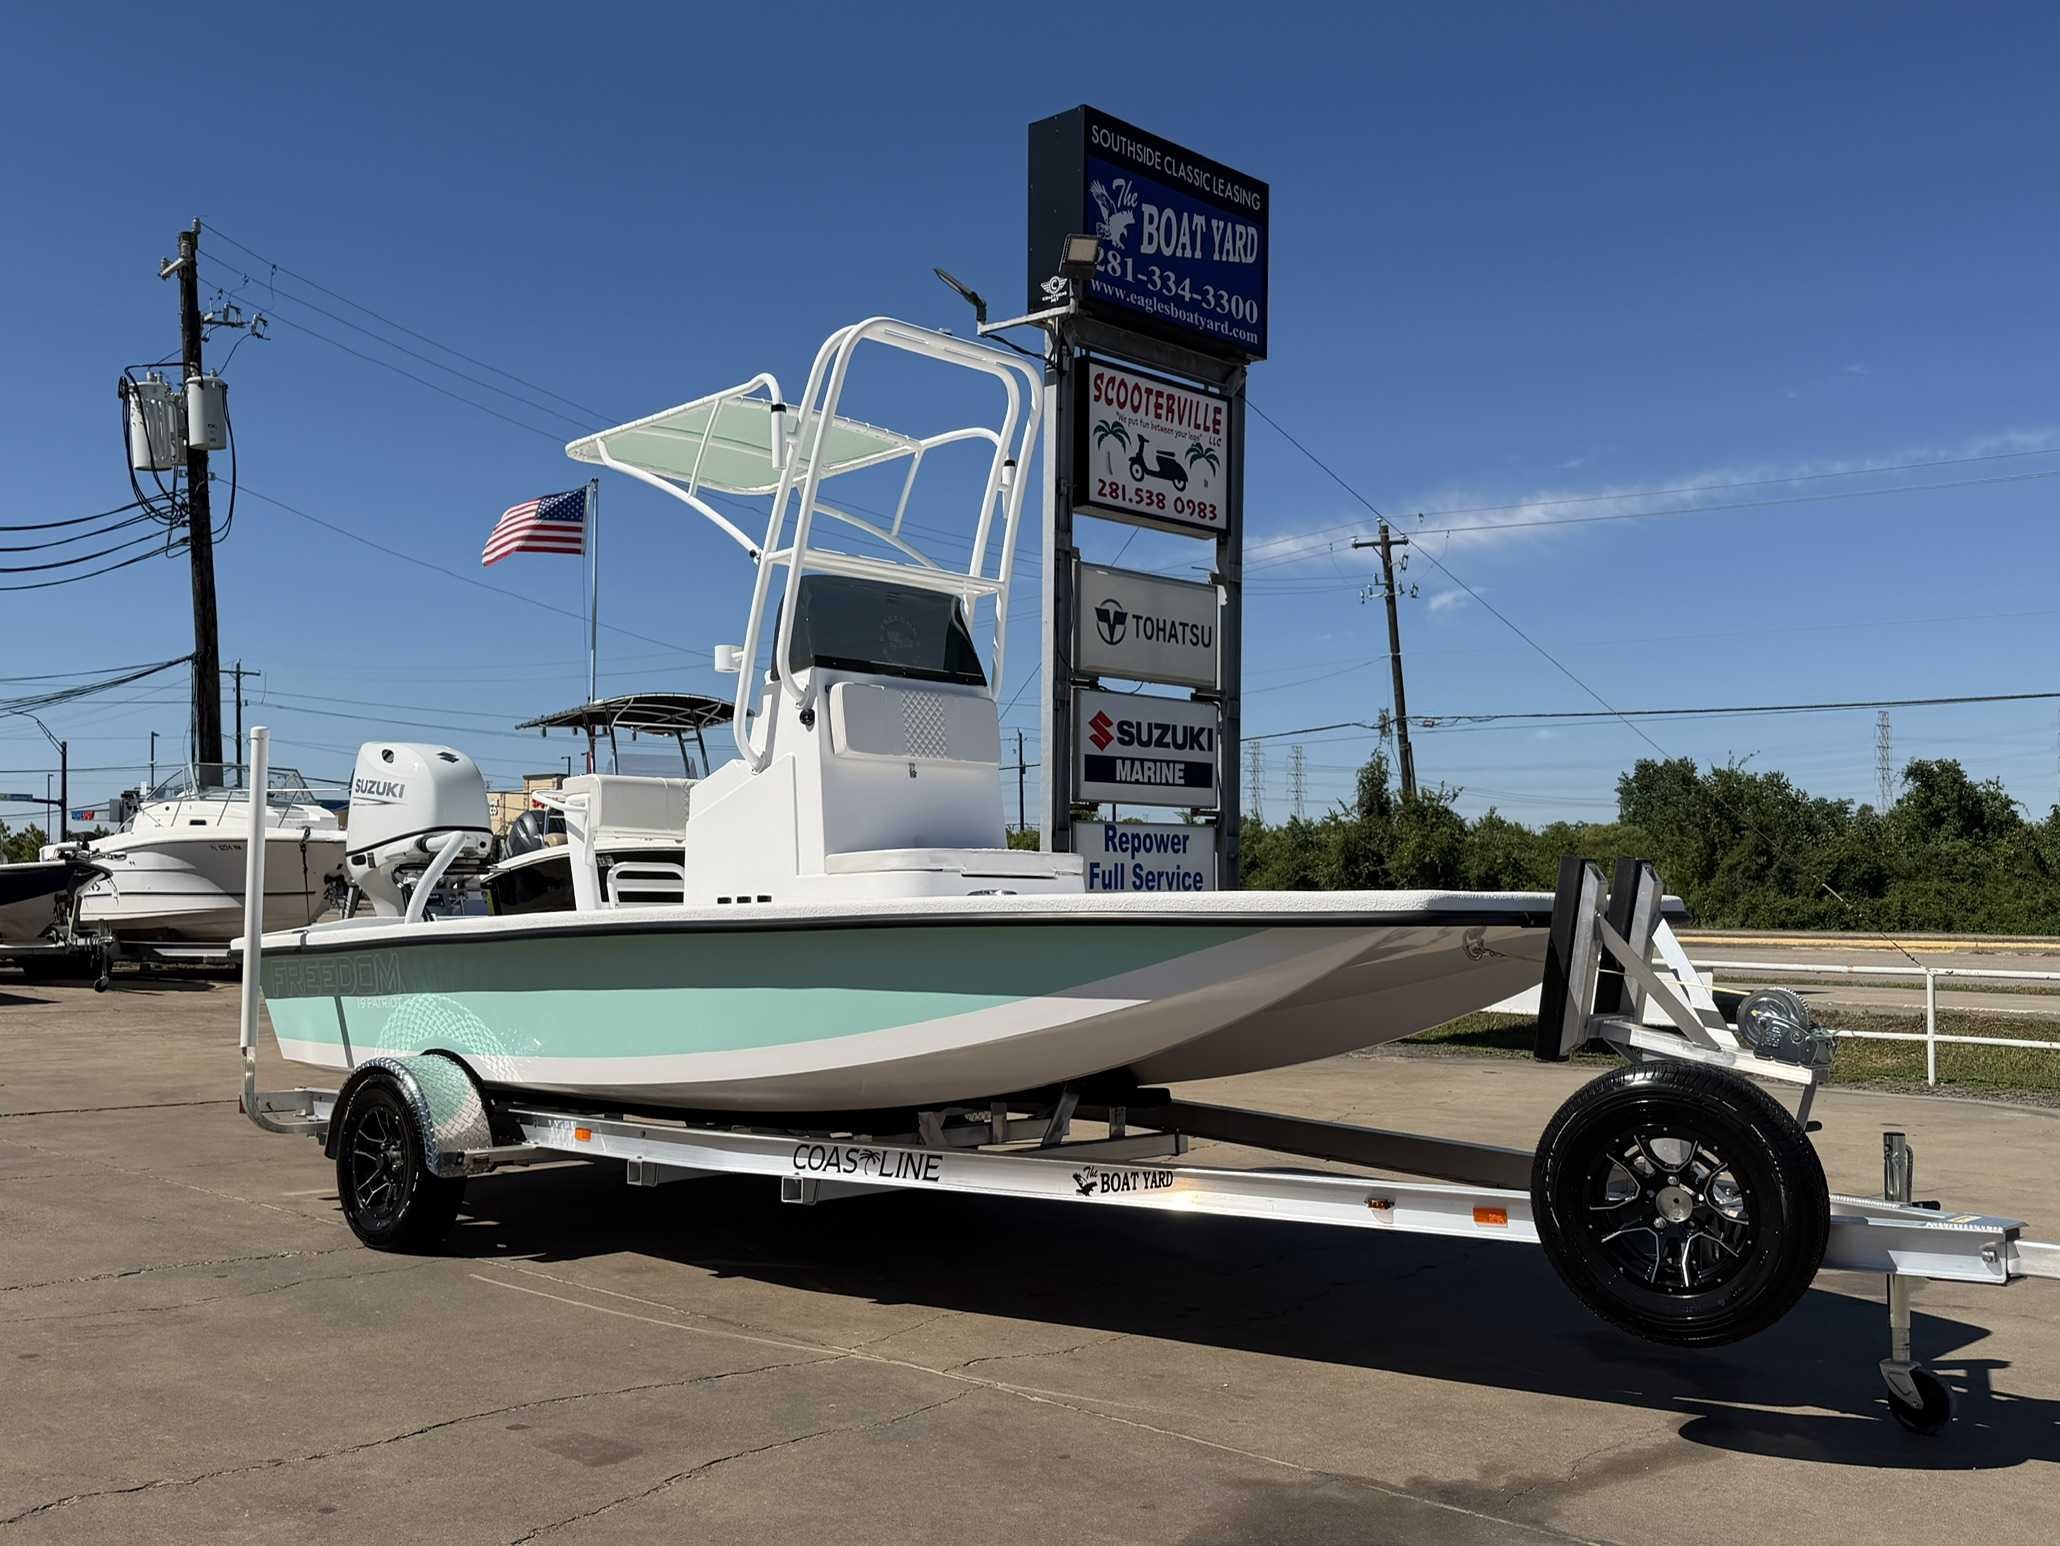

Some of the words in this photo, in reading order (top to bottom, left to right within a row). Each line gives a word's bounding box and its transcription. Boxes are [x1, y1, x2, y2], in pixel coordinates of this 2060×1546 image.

[1091, 124, 1162, 171] SOUTHSIDE
[1164, 156, 1211, 192] CLASSIC
[1212, 178, 1261, 211] LEASING
[1112, 178, 1138, 209] The
[1140, 203, 1206, 260] BOAT
[1211, 218, 1258, 264] YARD
[1096, 246, 1258, 325] 281-334-3300
[1090, 279, 1258, 344] www.eaglesboatyard.com
[1093, 372, 1222, 435] SCOOTERVILLE
[1208, 435, 1222, 447] LLC
[1174, 496, 1217, 521] 0983
[1132, 614, 1212, 648] TOHATSU
[1116, 719, 1214, 752] SUZUKI
[355, 778, 406, 799] SUZUKI
[1115, 759, 1185, 785] MARINE
[1104, 824, 1190, 860] Repower
[1089, 862, 1125, 891] Full
[1132, 863, 1203, 892] Service
[271, 952, 405, 996] FREEDOM
[1083, 1166, 1098, 1179] The
[1100, 1171, 1139, 1193] BOAT
[1143, 1170, 1174, 1189] YARD
